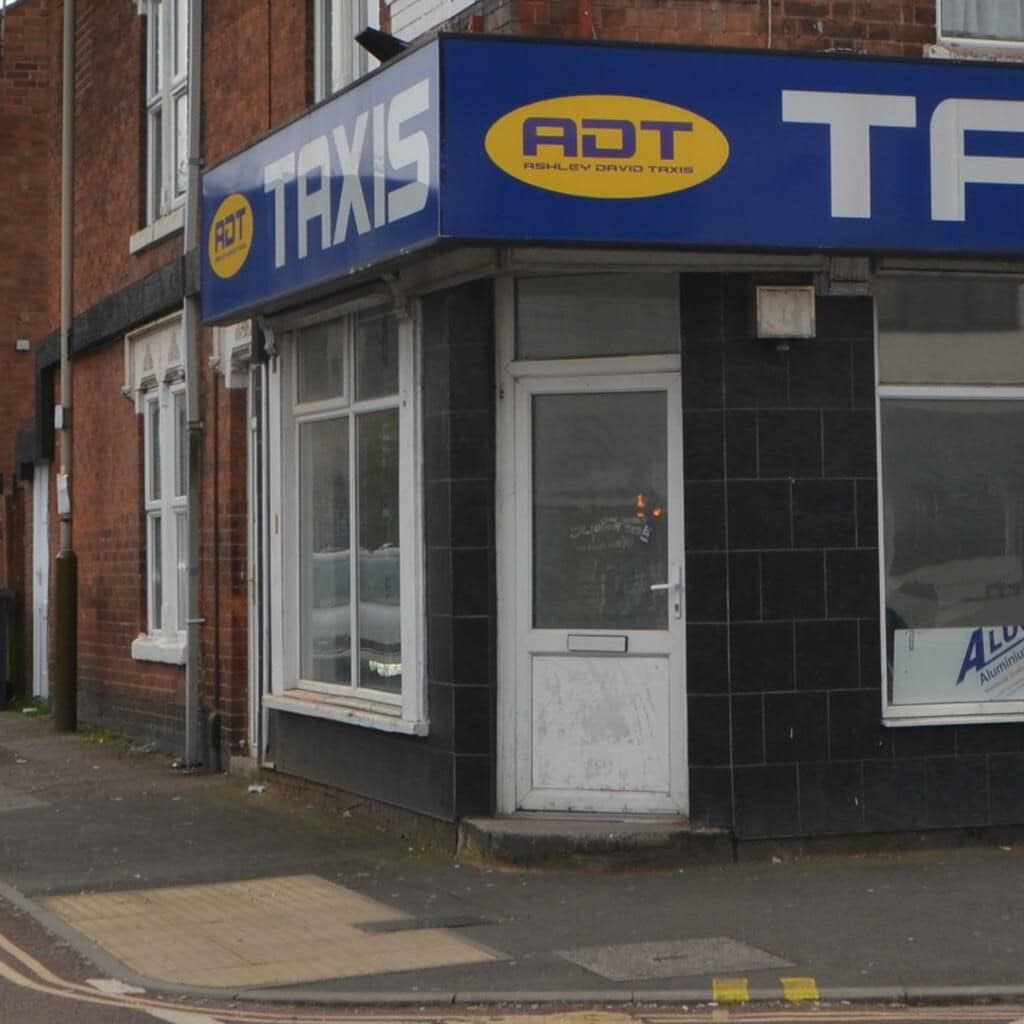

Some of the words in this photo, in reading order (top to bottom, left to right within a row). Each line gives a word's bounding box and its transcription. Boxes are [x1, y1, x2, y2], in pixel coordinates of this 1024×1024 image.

[523, 117, 694, 161] ADT
[264, 77, 430, 269] TAXIS
[523, 162, 591, 172] ASHLEY
[595, 163, 643, 173] DAVID
[648, 165, 694, 174] TAXIS
[215, 207, 246, 254] ADT
